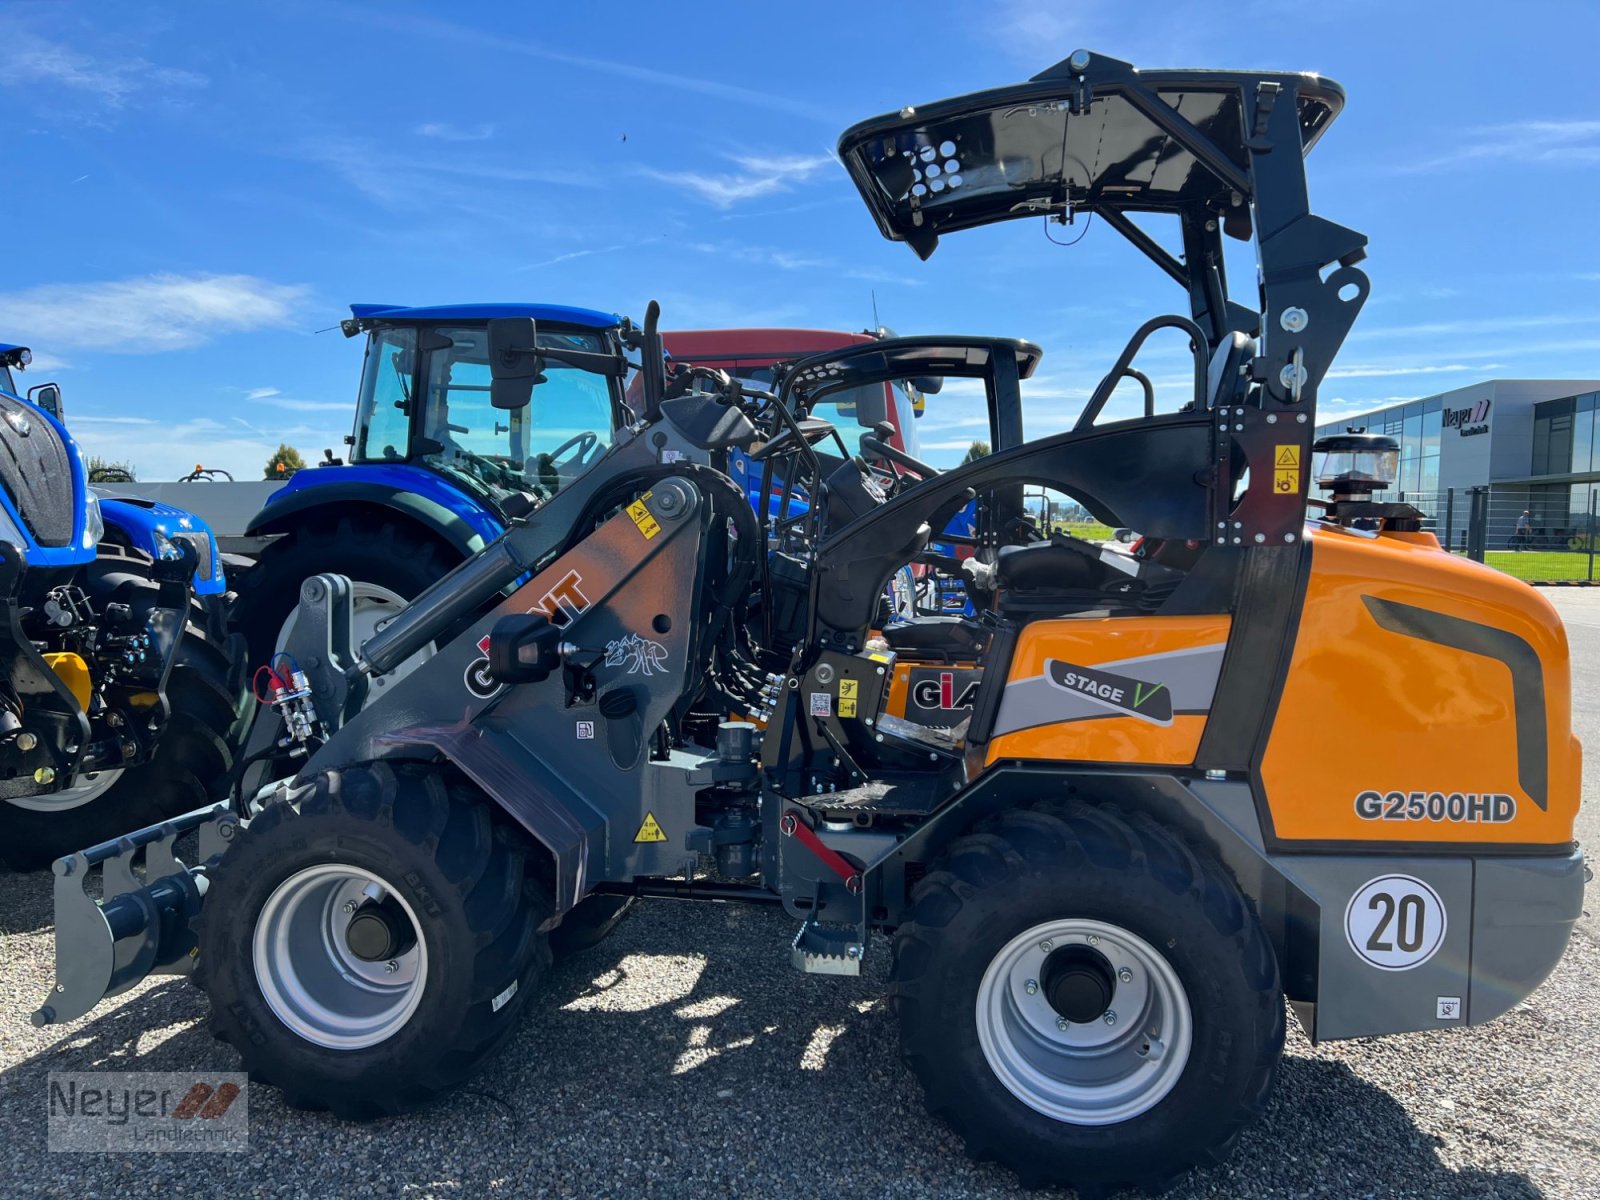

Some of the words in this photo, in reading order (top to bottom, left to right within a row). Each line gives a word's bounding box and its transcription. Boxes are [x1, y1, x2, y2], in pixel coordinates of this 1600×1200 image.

[1442, 408, 1472, 430] Neyer
[1064, 672, 1124, 703] STAGE
[1134, 682, 1164, 709] V
[1354, 789, 1517, 823] G2500HD
[403, 869, 442, 914] BKT
[1366, 892, 1426, 953] 20
